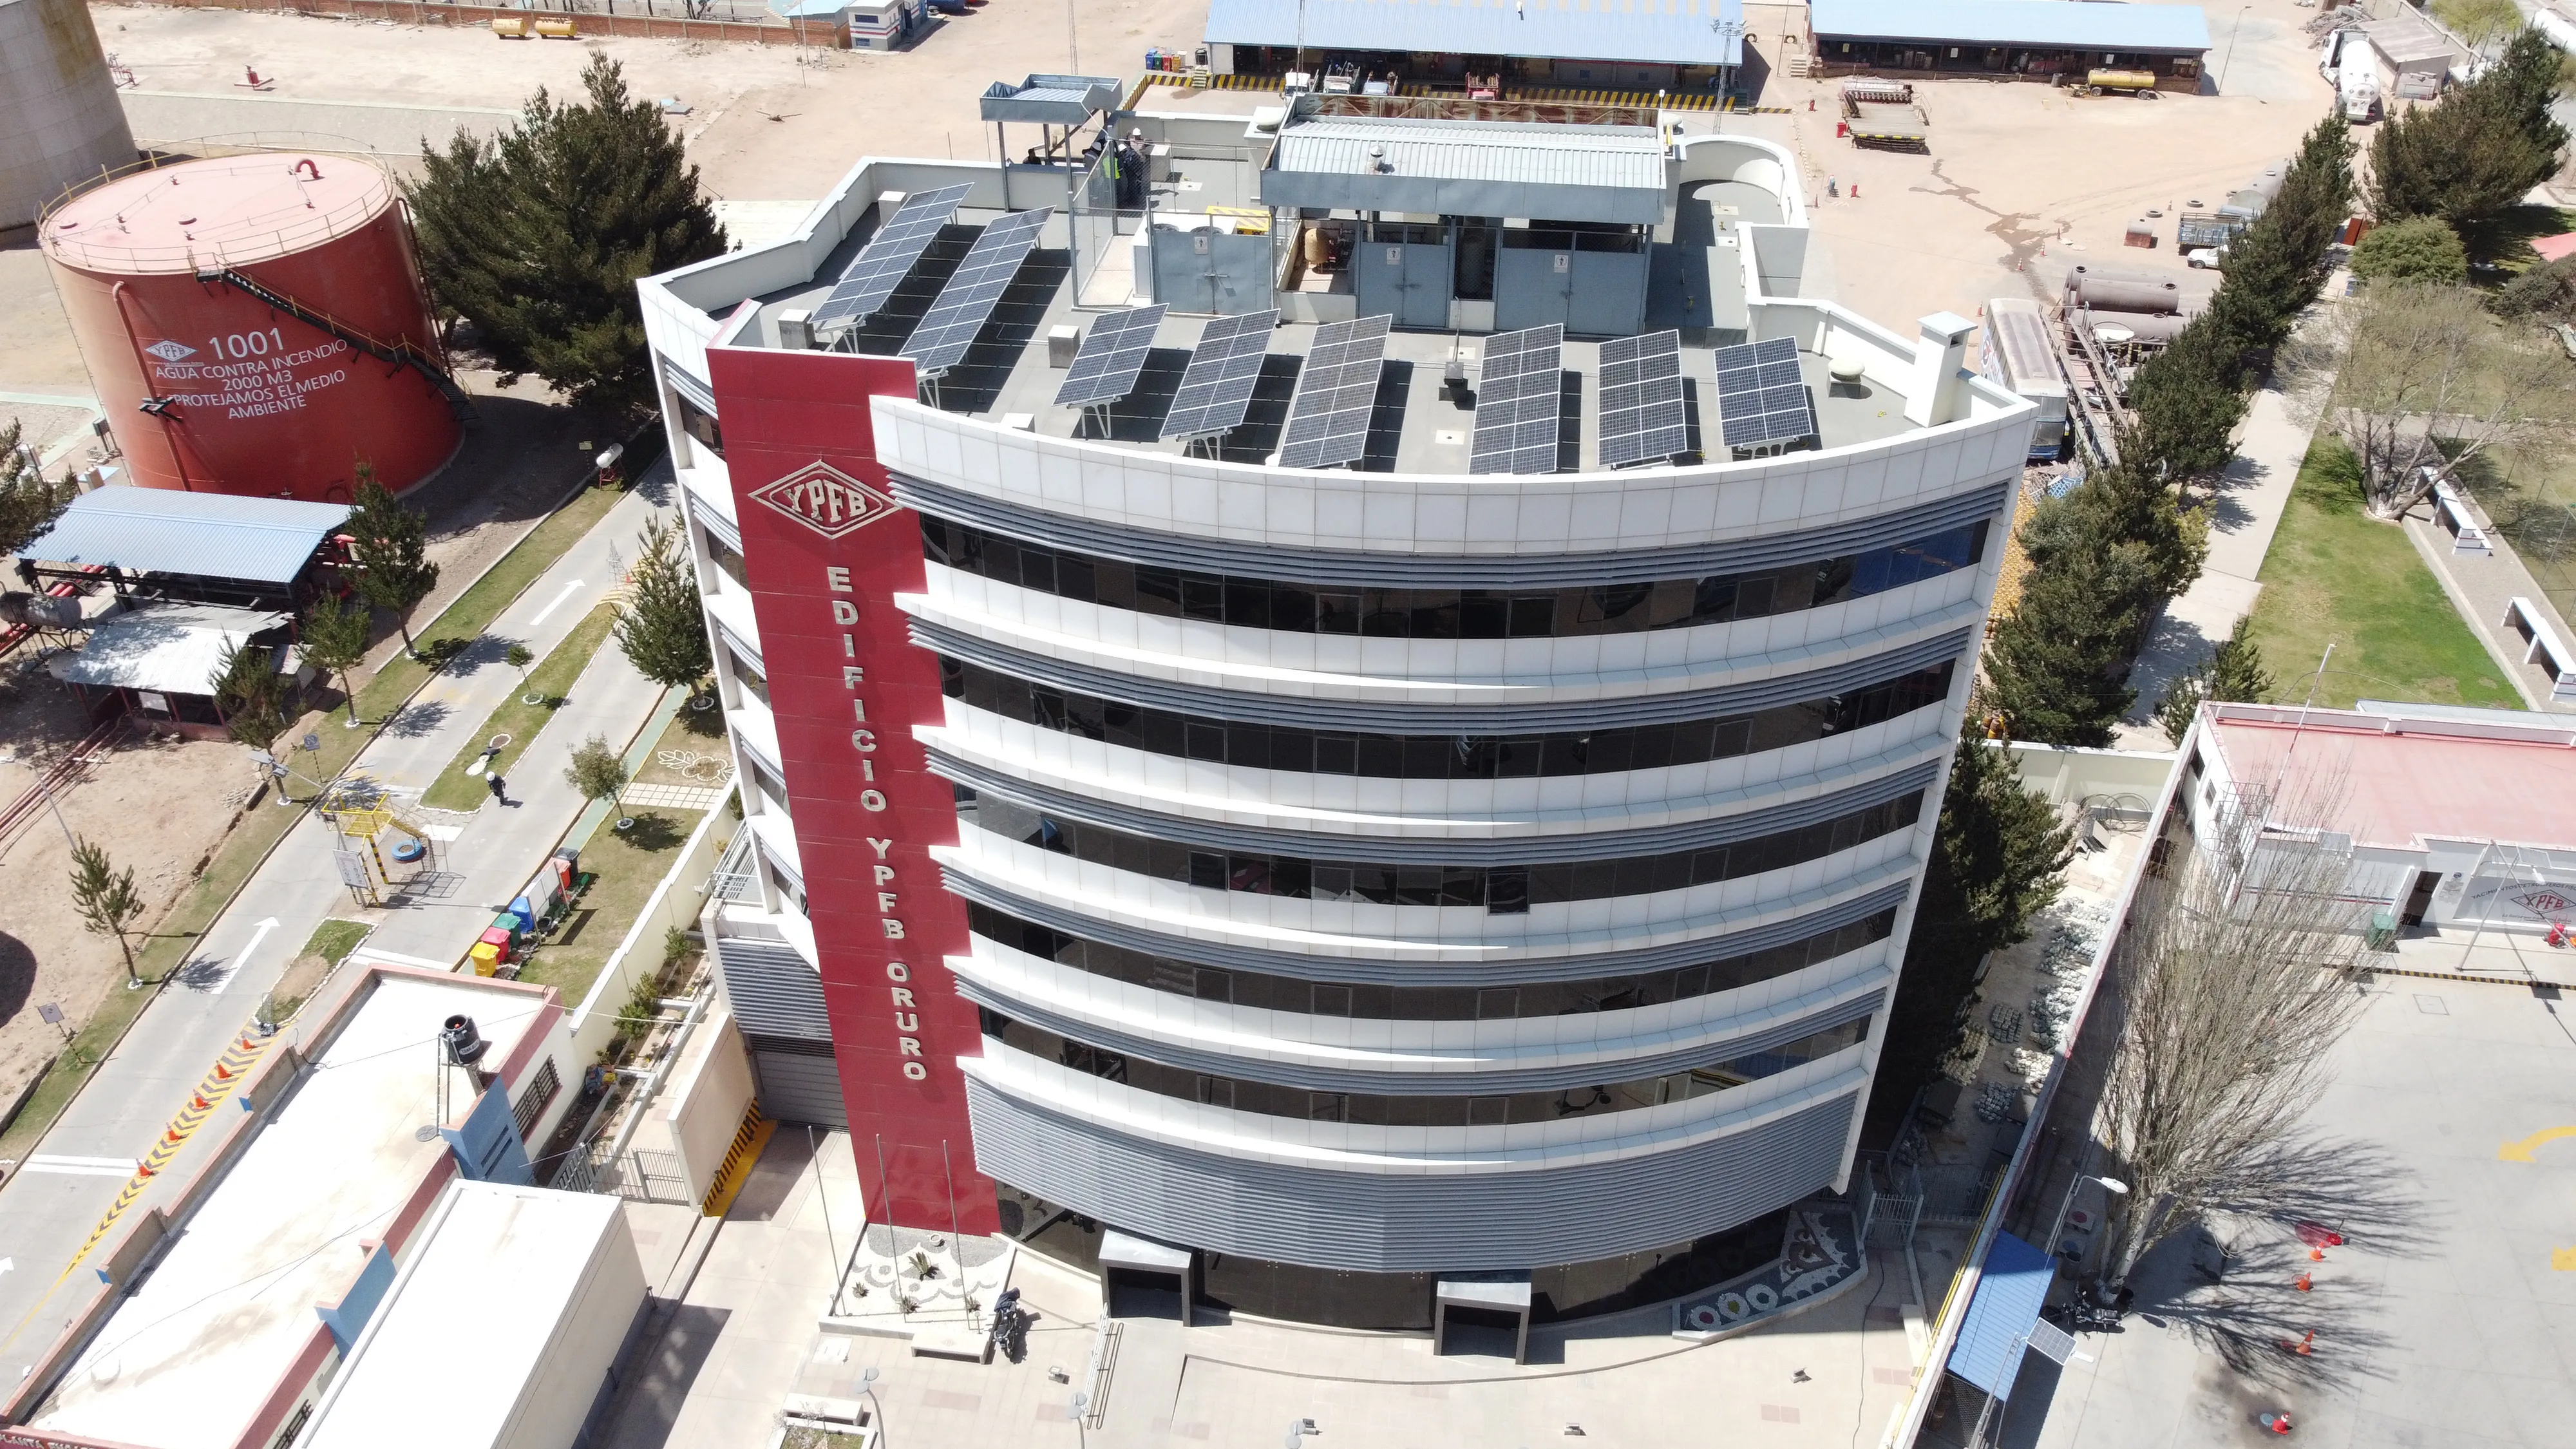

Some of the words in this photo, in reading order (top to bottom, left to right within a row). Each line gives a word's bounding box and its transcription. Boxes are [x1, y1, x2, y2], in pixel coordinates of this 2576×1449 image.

[155, 344, 185, 358] YPFB
[156, 367, 200, 379] AGUA
[202, 360, 269, 378] CONTRA
[271, 339, 346, 370] INCENDIO
[209, 328, 283, 359] 1001
[173, 388, 274, 406] PROTEJAMOS
[278, 383, 297, 398] EL
[296, 370, 345, 393] MEDIO
[222, 375, 263, 391] 2000
[267, 370, 292, 385] M3
[229, 395, 307, 419] AMBIENTE
[782, 478, 867, 524] YPFB
[826, 566, 887, 812] EDIFICIO
[866, 837, 905, 940] YPFB
[886, 961, 927, 1080] ORURO
[2526, 895, 2564, 909] YPFB
